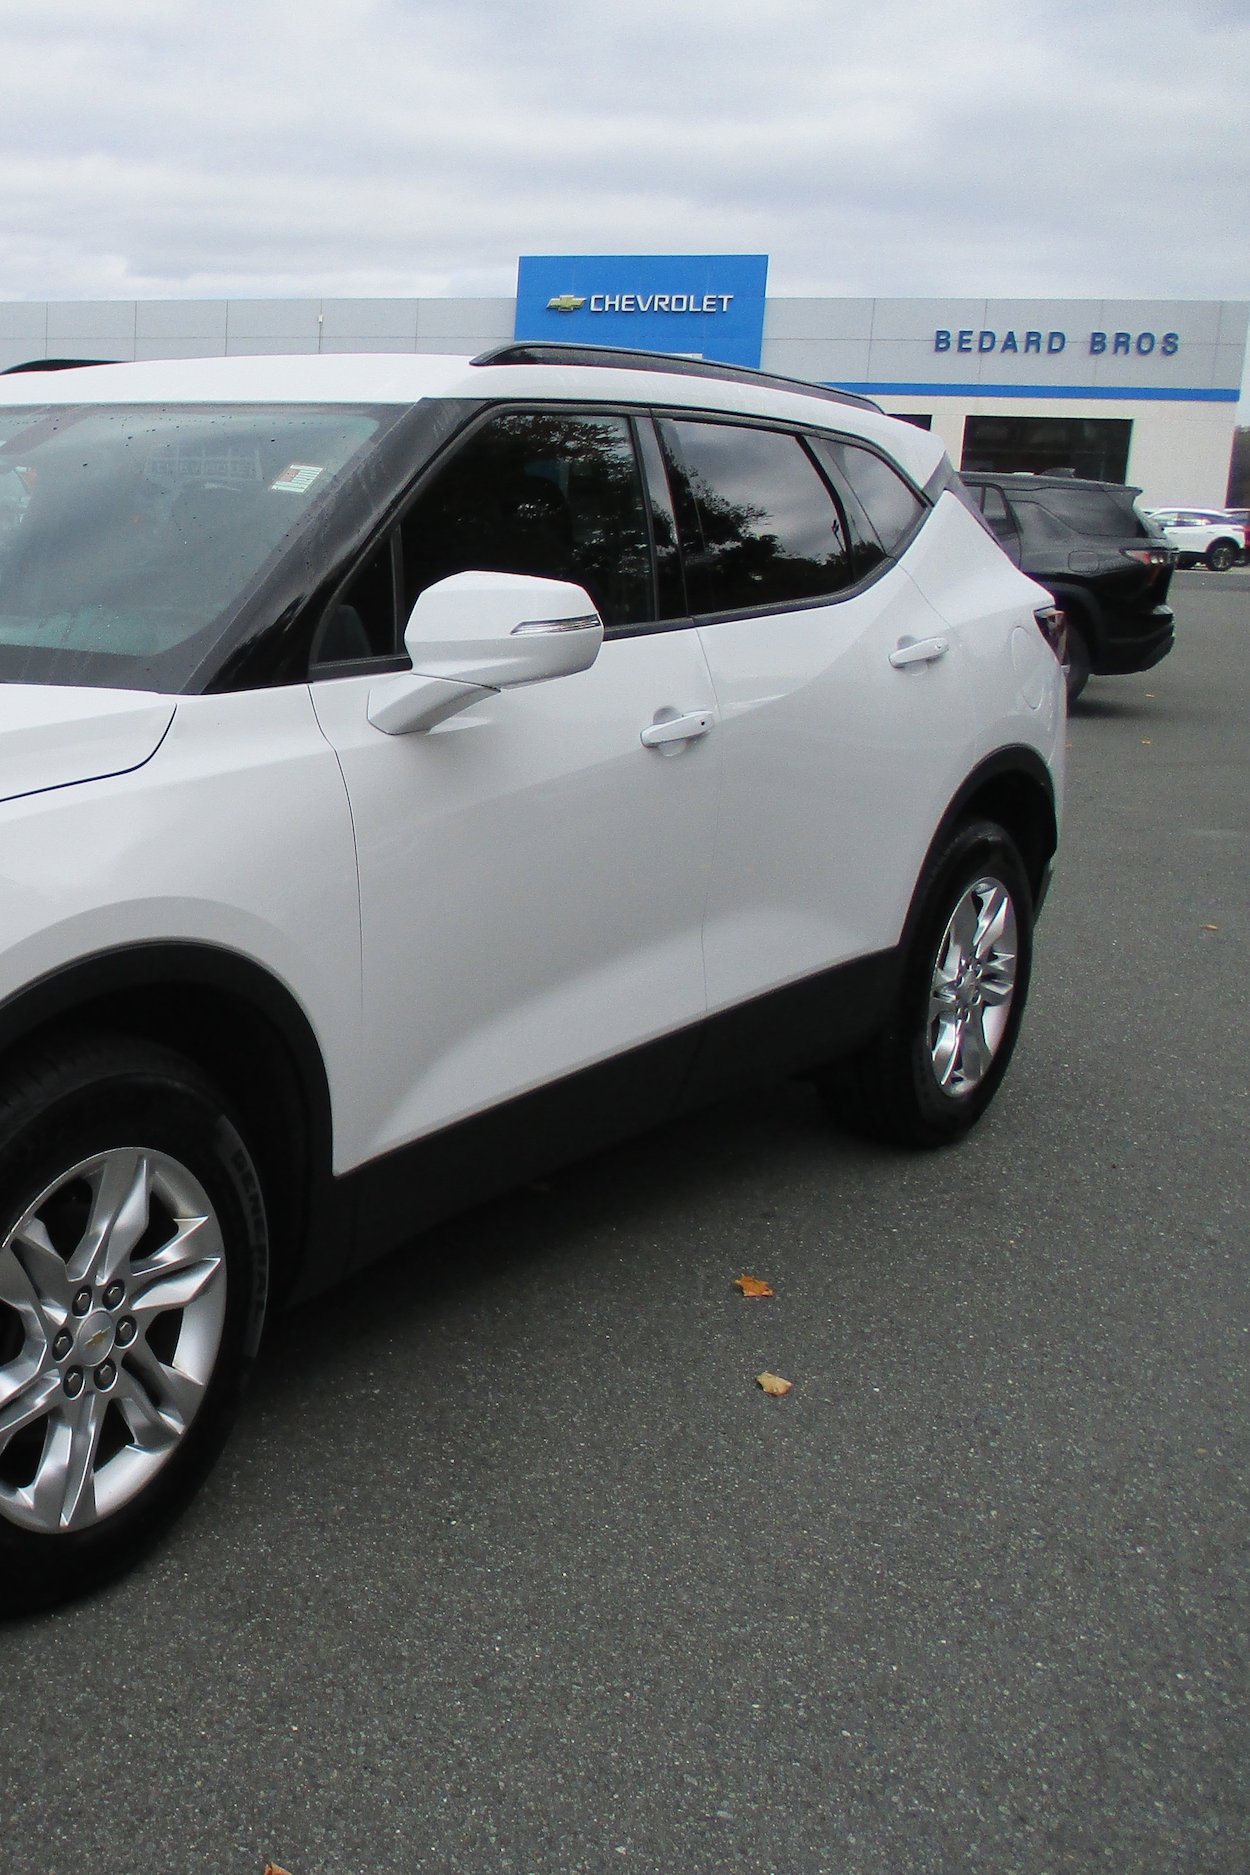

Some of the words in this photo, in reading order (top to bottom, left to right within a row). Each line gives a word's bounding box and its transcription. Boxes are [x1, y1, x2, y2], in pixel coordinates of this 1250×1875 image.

[590, 295, 734, 312] CHEVROLET
[935, 330, 1066, 353] BEDARD
[1089, 332, 1178, 355] BROS
